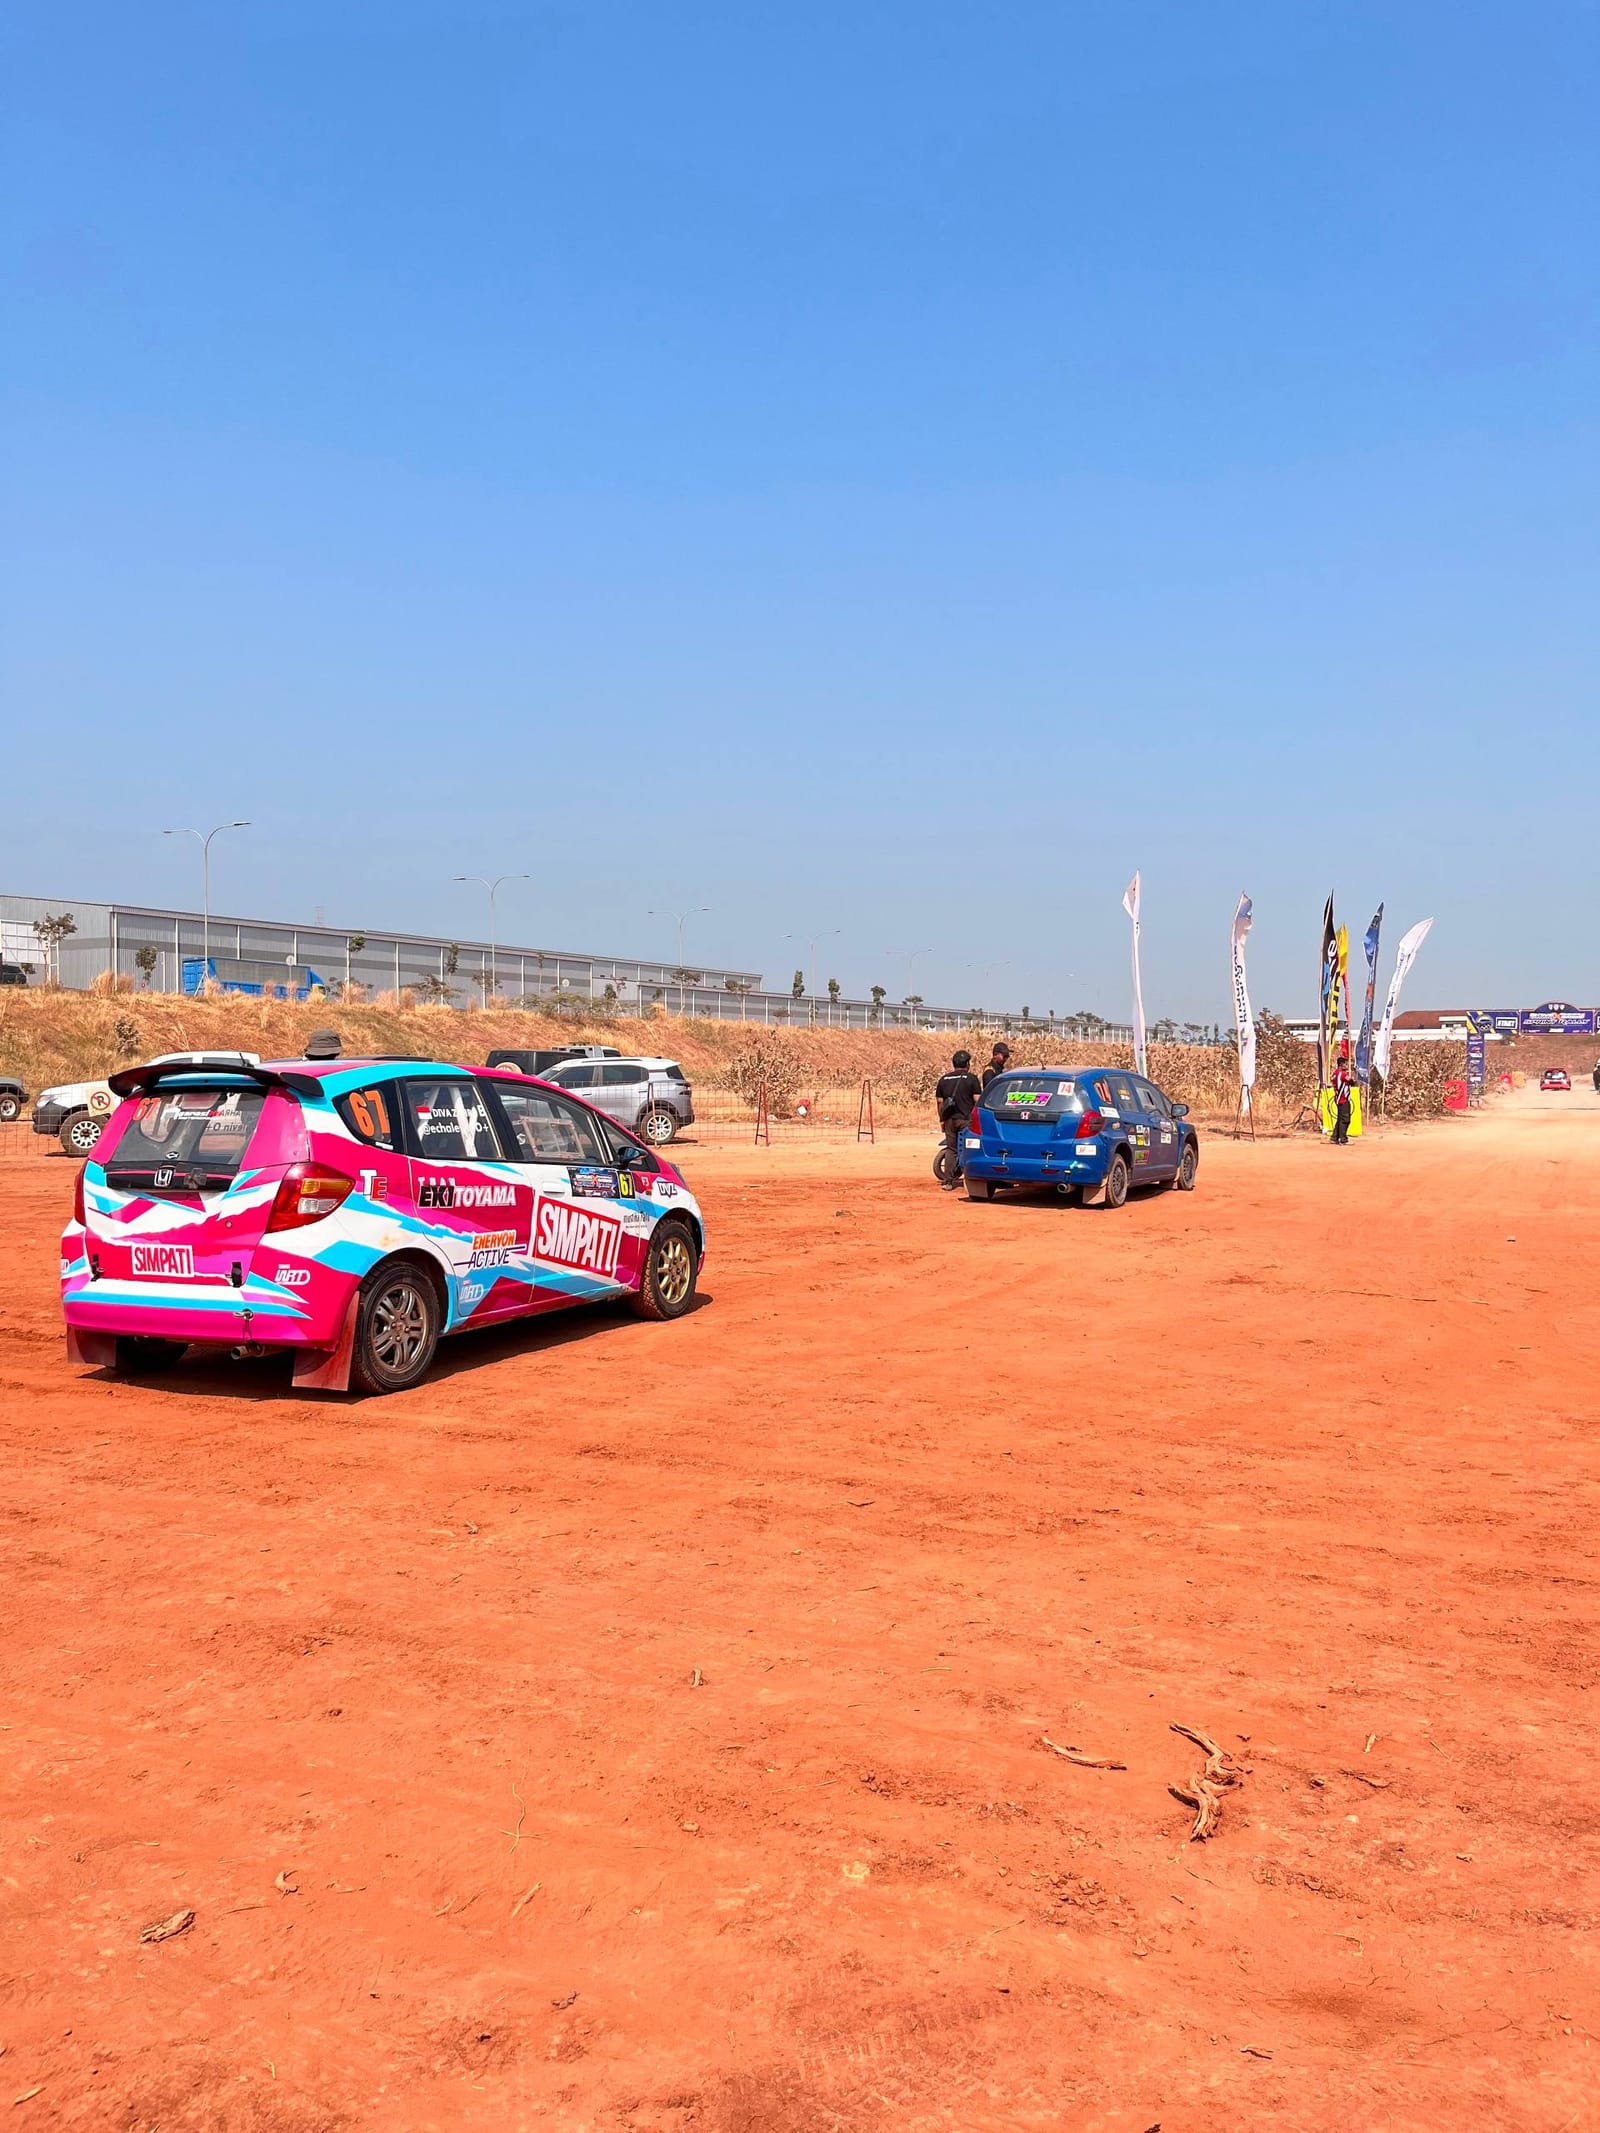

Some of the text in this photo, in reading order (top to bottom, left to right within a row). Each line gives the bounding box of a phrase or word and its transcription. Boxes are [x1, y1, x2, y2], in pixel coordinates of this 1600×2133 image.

[133, 1097, 161, 1121] 67
[349, 1090, 391, 1137] 67
[620, 1173, 633, 1196] 67
[473, 1230, 515, 1250] ENERVON
[538, 1203, 619, 1272] SIMPATI
[134, 1246, 191, 1274] SIMPATI
[468, 1248, 510, 1268] ACTIVE
